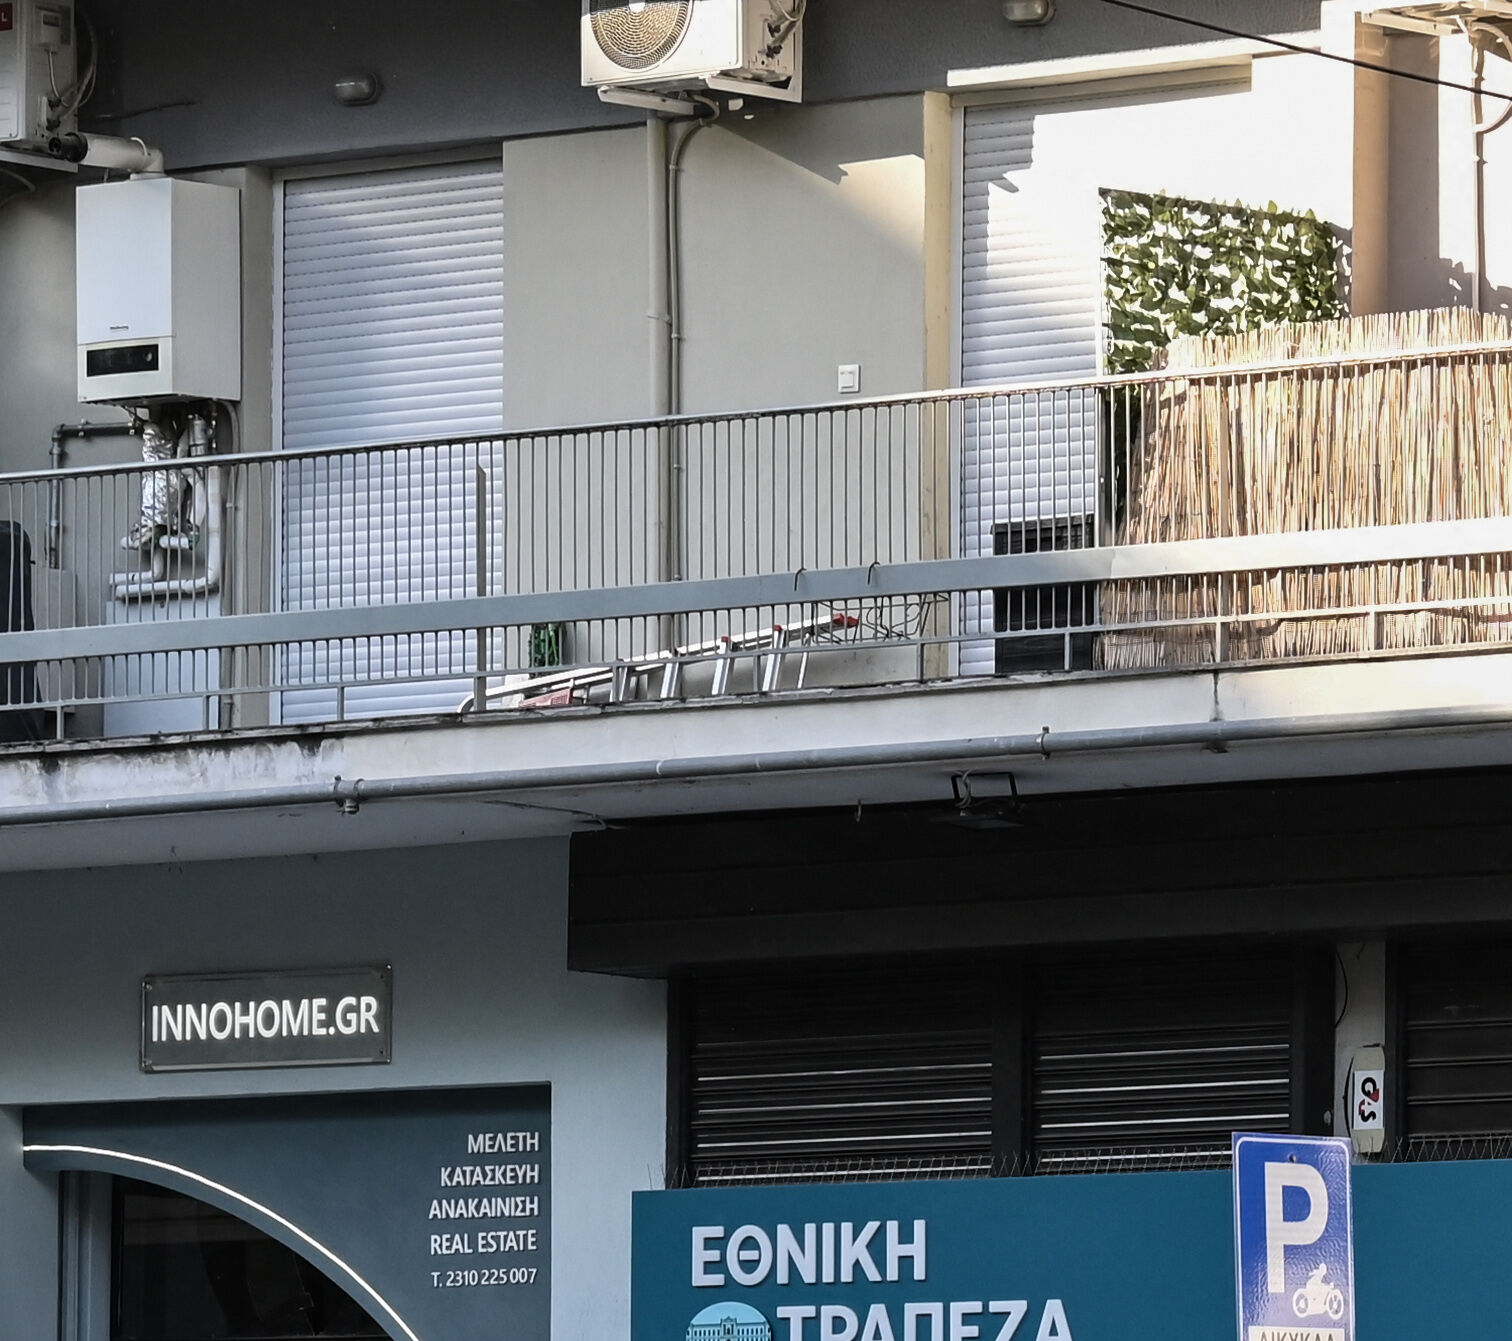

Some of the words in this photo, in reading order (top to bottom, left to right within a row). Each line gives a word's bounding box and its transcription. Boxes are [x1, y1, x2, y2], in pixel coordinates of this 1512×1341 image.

[152, 996, 380, 1042] INNOHOME.GR
[467, 1131, 539, 1154] ΜΕΛΕΤΗ
[440, 1164, 539, 1188] ΚΑΤΑΣΚΕΥΗ
[429, 1196, 539, 1220] ΑΝΑΚΑΙΝΙΣΗ
[1264, 1161, 1329, 1293] P
[430, 1234, 473, 1256] REAL
[477, 1230, 537, 1254] ESTATE
[691, 1219, 927, 1287] ΕΘΝΙΚΗ
[446, 1270, 482, 1287] 2310
[483, 1269, 509, 1286] 225
[510, 1268, 537, 1285] 007
